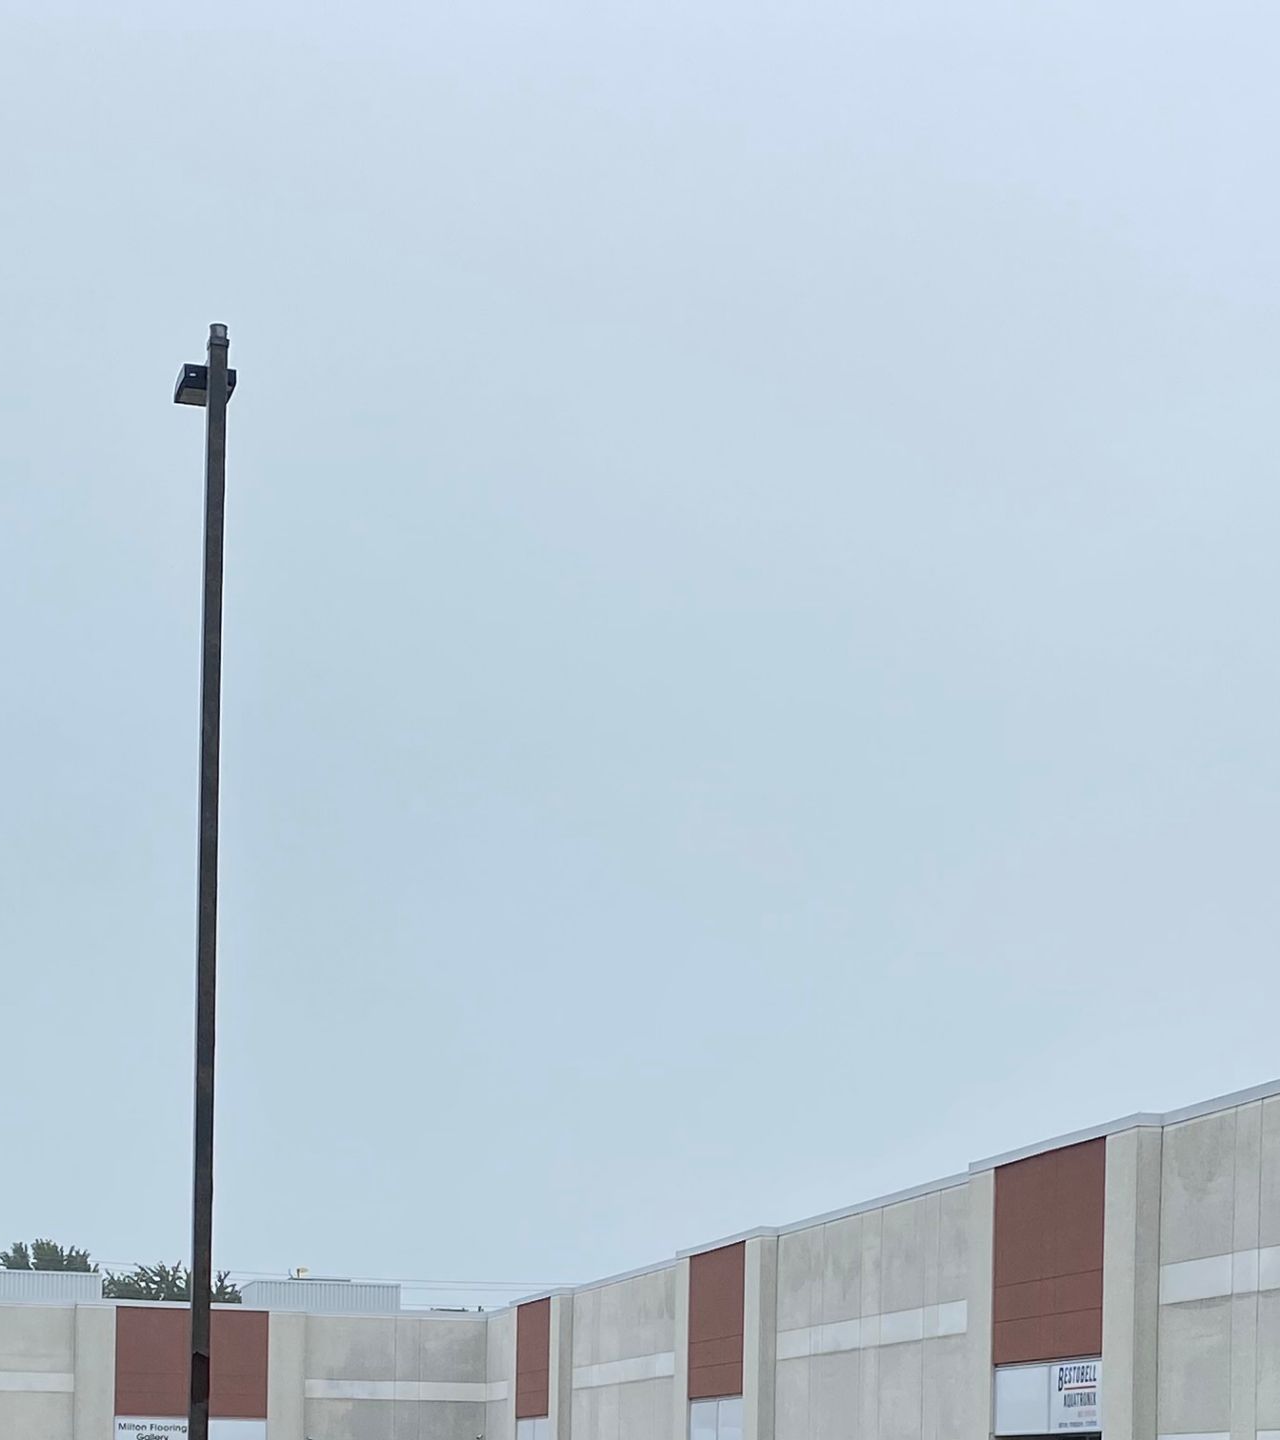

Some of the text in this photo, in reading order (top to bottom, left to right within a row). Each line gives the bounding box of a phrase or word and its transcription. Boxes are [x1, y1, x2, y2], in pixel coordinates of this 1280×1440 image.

[1058, 1365, 1096, 1391] BESTOBELL
[118, 1422, 187, 1434] Milton Flooring
